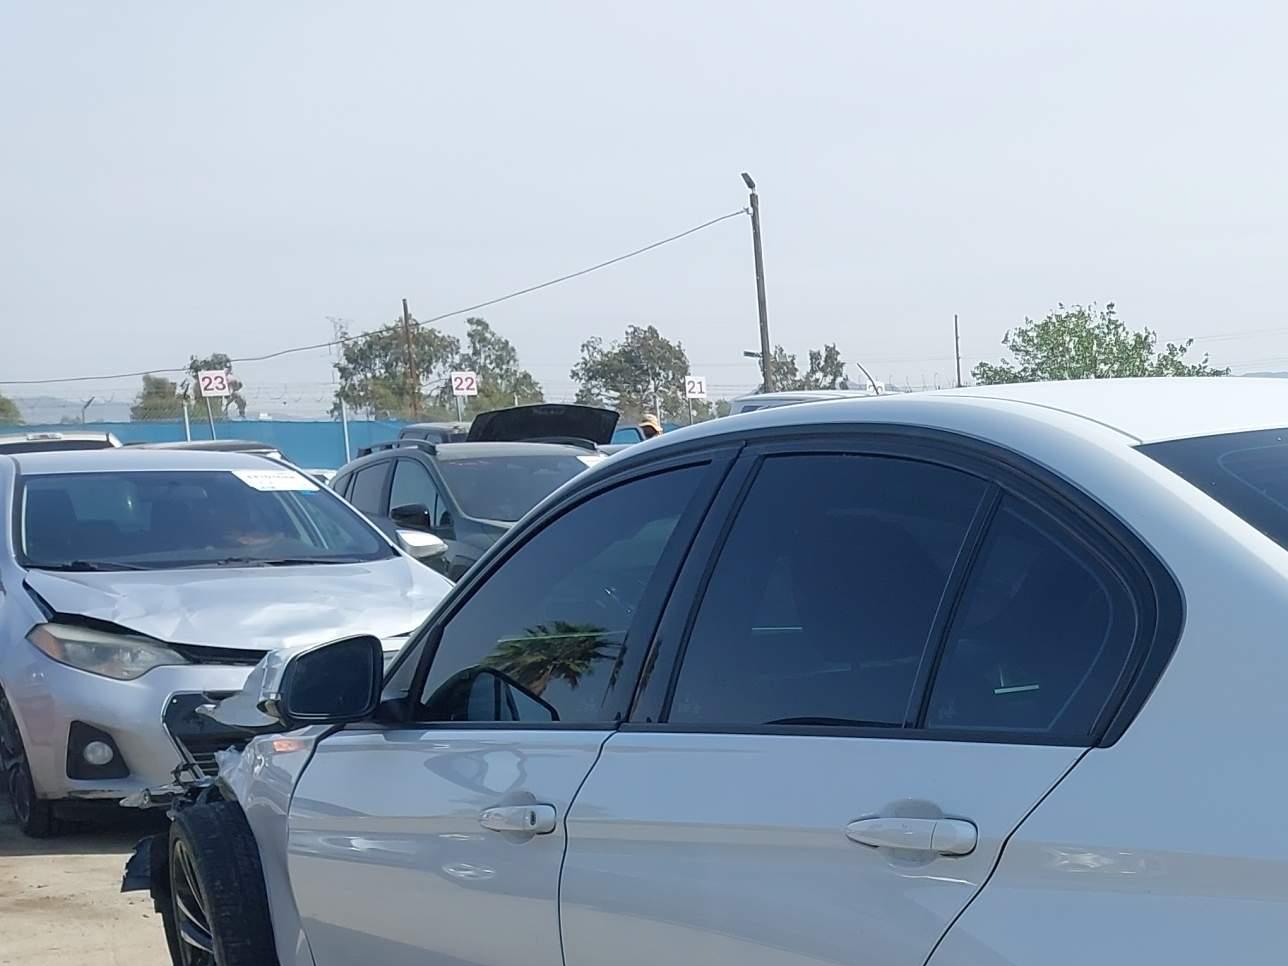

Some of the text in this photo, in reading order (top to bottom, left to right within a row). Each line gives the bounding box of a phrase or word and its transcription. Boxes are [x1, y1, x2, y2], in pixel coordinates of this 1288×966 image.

[201, 375, 226, 391] 23
[454, 376, 476, 391] 22
[687, 380, 705, 395] 21
